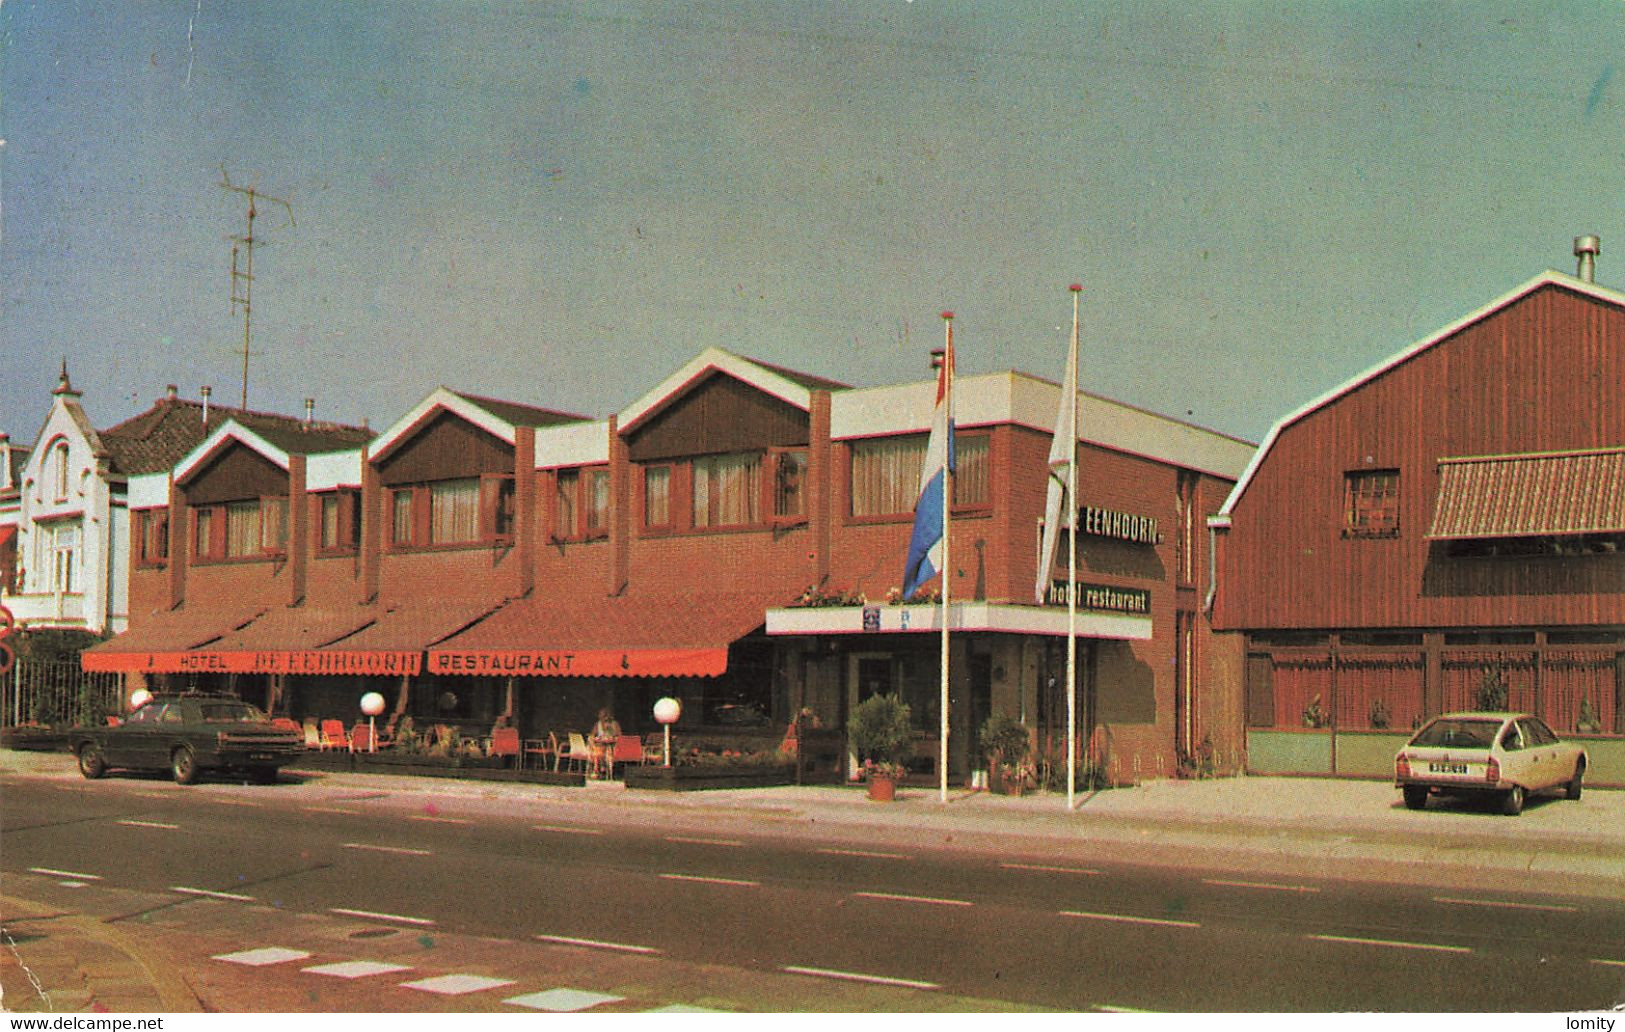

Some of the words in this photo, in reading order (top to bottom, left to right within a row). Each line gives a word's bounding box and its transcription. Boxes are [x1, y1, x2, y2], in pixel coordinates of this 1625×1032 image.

[1050, 580, 1081, 606] hotl
[1086, 588, 1146, 611] restaurant
[181, 655, 227, 669] HOTEL
[255, 653, 282, 669] DE
[439, 655, 575, 670] RESTAURANT
